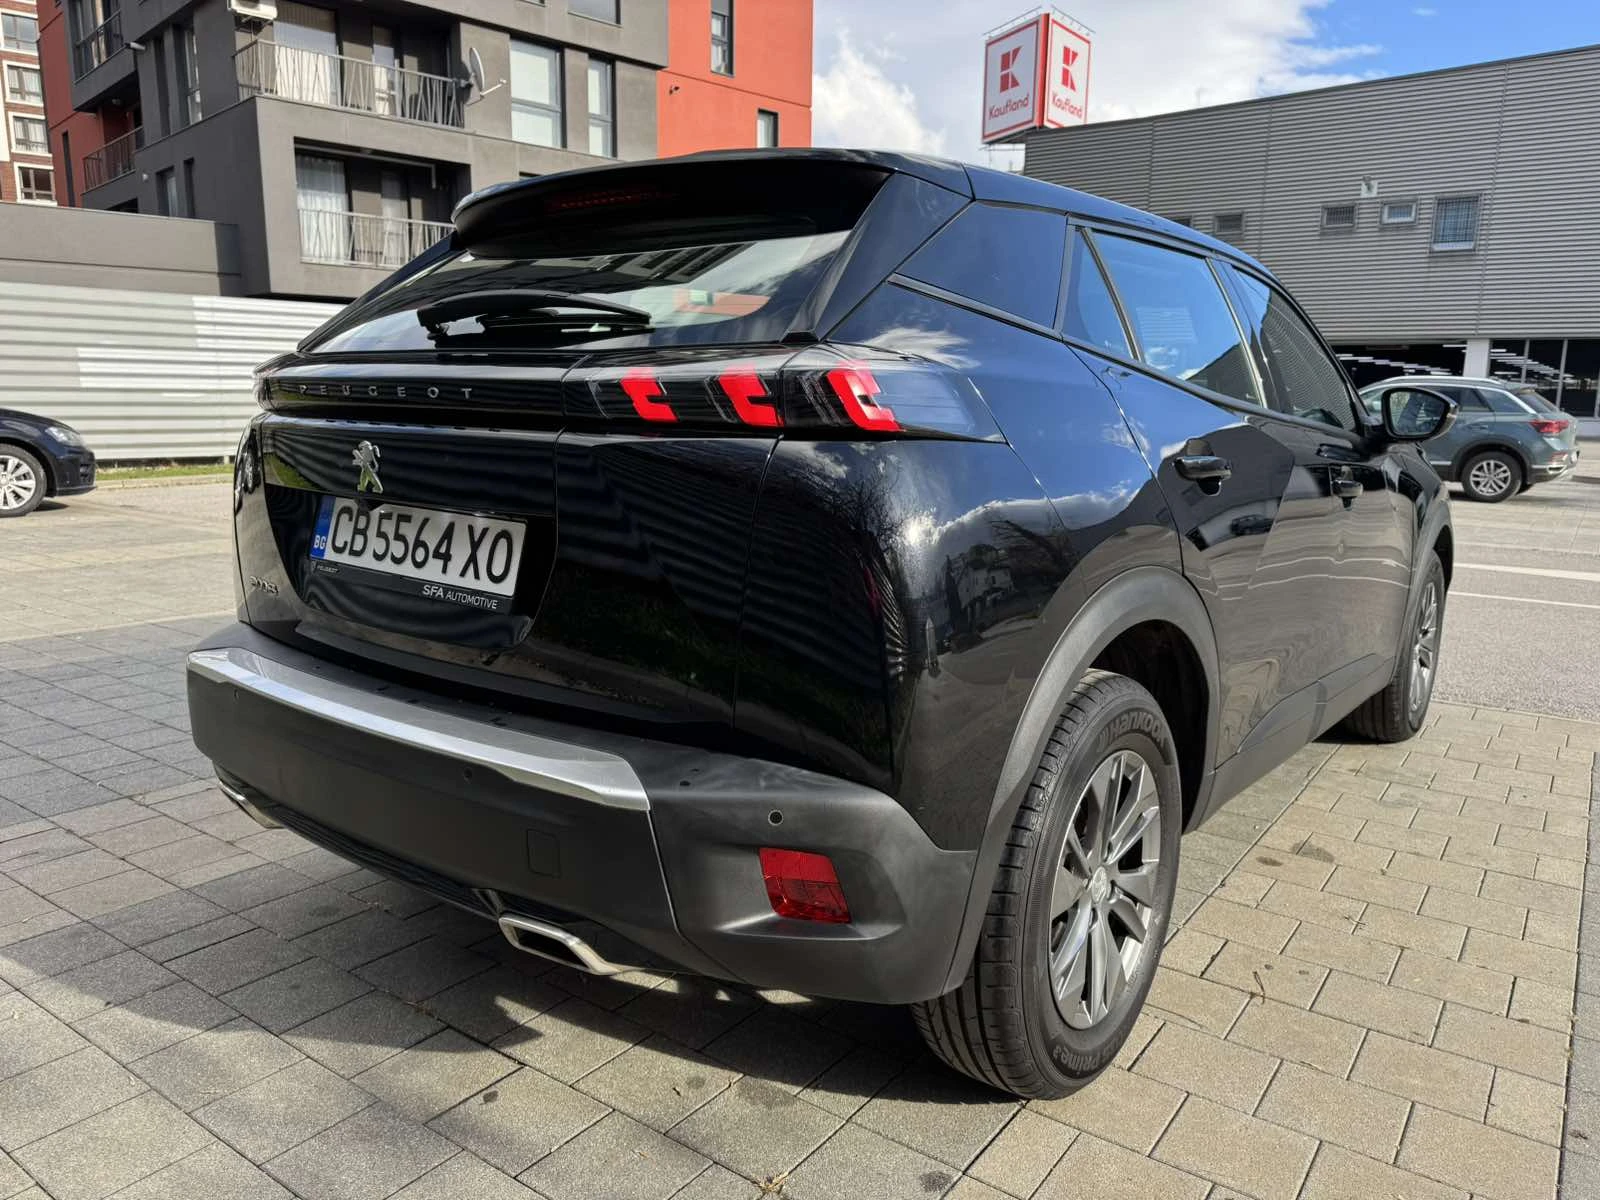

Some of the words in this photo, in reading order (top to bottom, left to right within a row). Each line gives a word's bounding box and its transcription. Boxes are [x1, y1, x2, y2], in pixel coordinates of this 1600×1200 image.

[989, 93, 1029, 119] Kaufland
[1052, 92, 1083, 118] Kaufland
[299, 384, 472, 399] PEUGEOT
[314, 534, 327, 550] BG
[422, 584, 444, 599] SFA
[445, 591, 498, 610] AUTOMOTIVE
